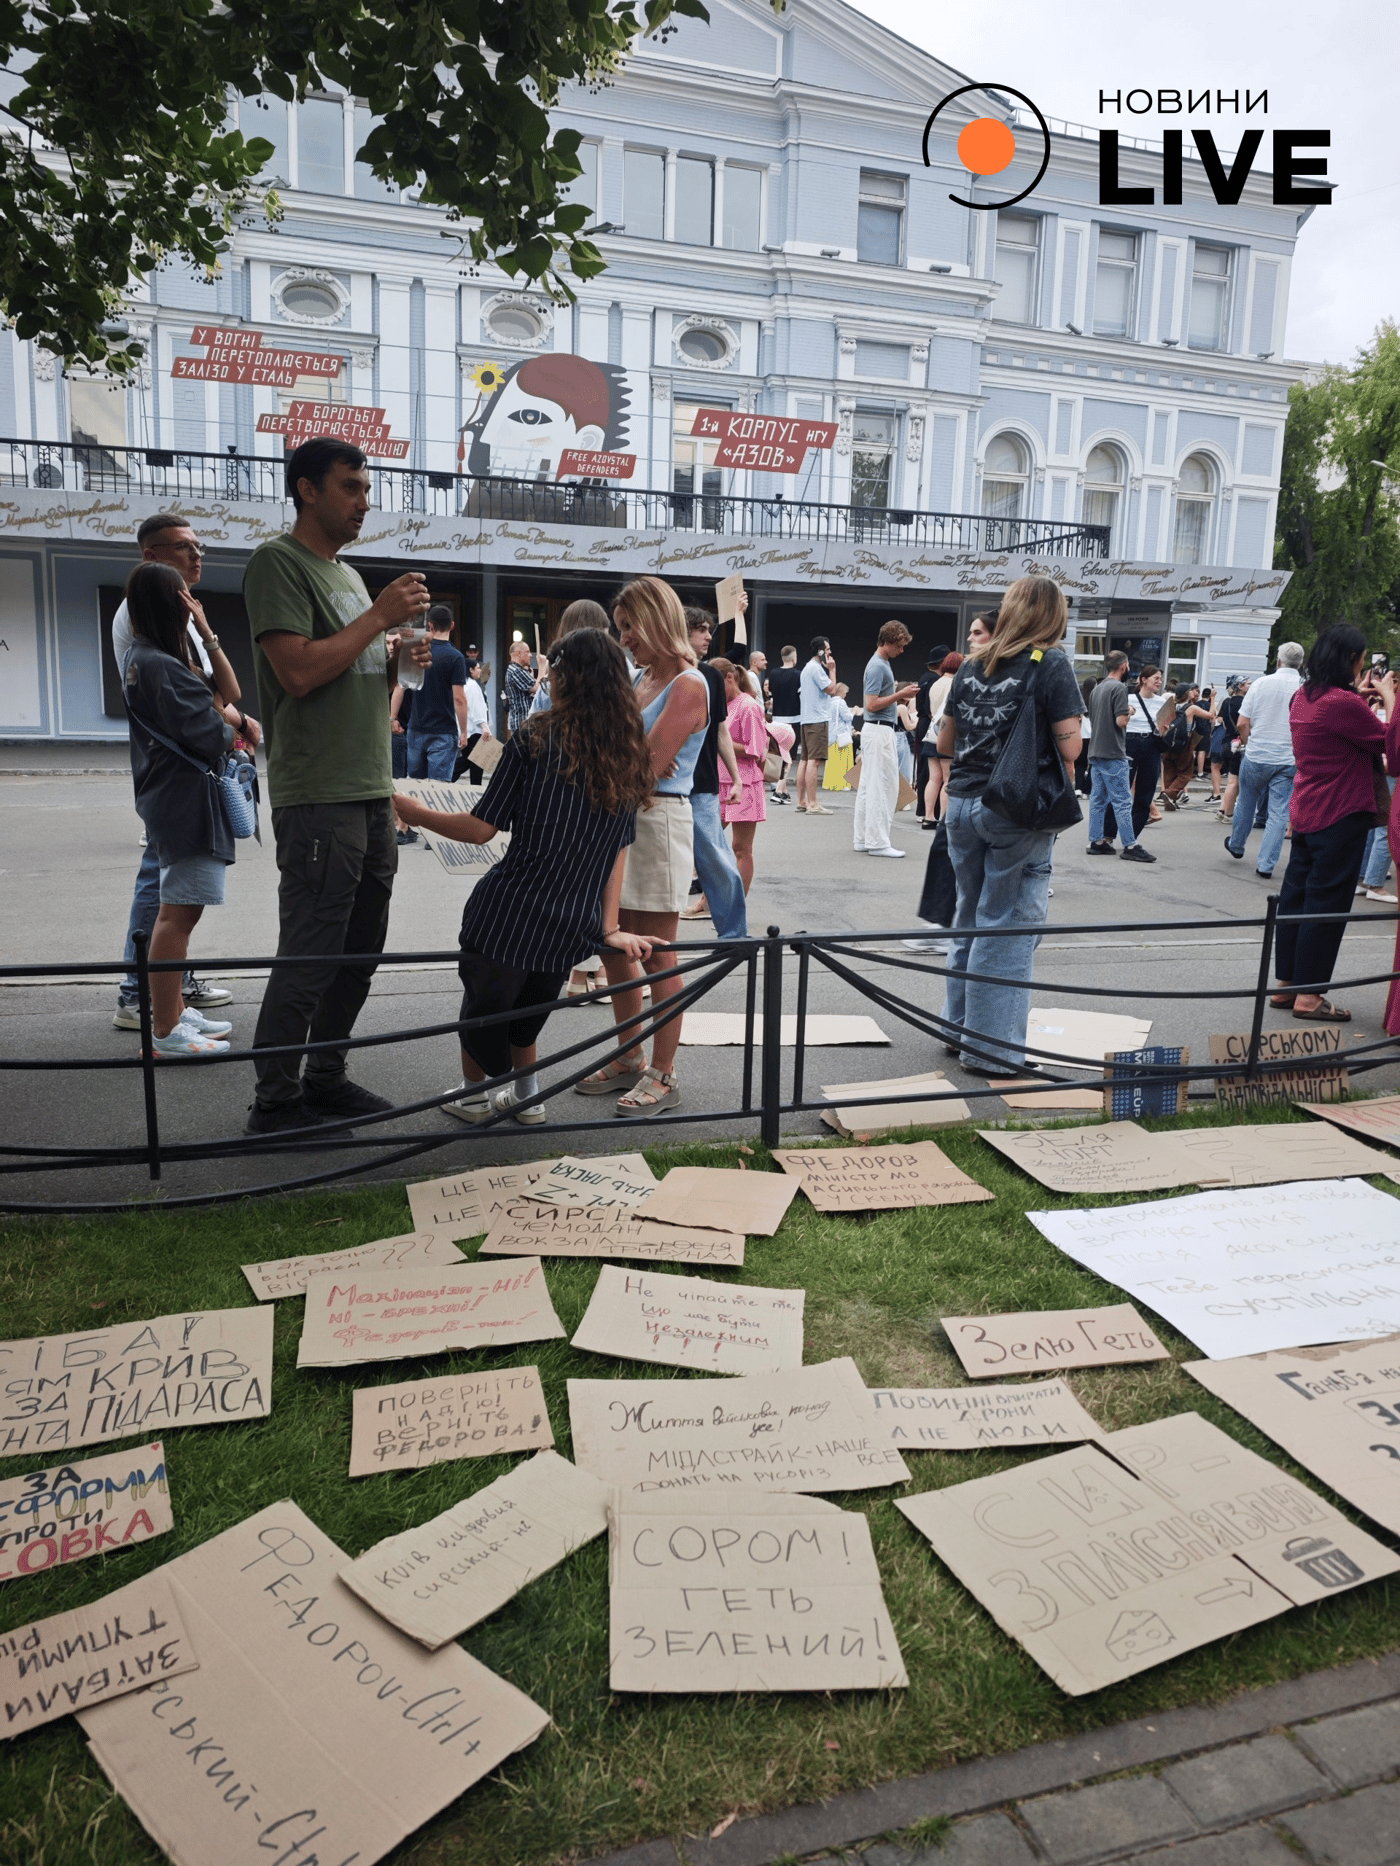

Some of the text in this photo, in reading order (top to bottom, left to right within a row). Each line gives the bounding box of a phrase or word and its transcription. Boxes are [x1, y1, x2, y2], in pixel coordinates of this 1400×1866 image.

[198, 330, 256, 347] У ВОГНІ
[211, 348, 339, 372] ПЕРЕТОПЛЮЄТЬСЯ
[178, 362, 293, 385] ЗАЛІЗО У СТАЛЬ
[296, 404, 376, 423] У БОРОТЬБІ
[262, 416, 383, 439] ПЕРЕТВОРЮЄТЬСЯ
[700, 417, 828, 443] 1-й КОРПУС НГУ
[567, 452, 630, 467] FREE AZOVSTAL
[722, 444, 795, 467] «АЗОВ»
[577, 464, 620, 476] DEFENDERS
[786, 1154, 918, 1171] ФЕДОРОВ
[1039, 1145, 1113, 1160] ЧОРТ
[549, 1162, 611, 1185] ЛАСКА
[807, 1173, 879, 1183] МІНІСТР
[441, 1179, 479, 1199] ЦЕ
[488, 1174, 518, 1190] НЕ
[534, 1183, 570, 1198] Z
[612, 1180, 655, 1198] УДЬ
[434, 1206, 480, 1224] ЦЕ
[498, 1236, 615, 1247] ВОКЗАЛ
[624, 1275, 653, 1297] Не
[684, 1312, 761, 1329] має бути
[89, 1349, 252, 1393] КРИВ
[996, 1386, 1062, 1405] ВМИРАТИ
[2, 1391, 69, 1421] ЗА
[80, 1377, 266, 1436] ПІДАРАСА
[954, 1405, 1036, 1423] ДРОНИ
[609, 1400, 705, 1433] Життя
[919, 1427, 950, 1440] НЕ
[978, 1423, 1069, 1440] ЛЮДИ
[857, 1450, 899, 1466] ВСЕ
[21, 1467, 82, 1497] ЗА
[718, 1474, 743, 1483] НА
[0, 1509, 103, 1548] ПРОТИ
[680, 1587, 813, 1614] ГЕТЬ
[18, 1606, 168, 1678] ТУПИМИ
[625, 1617, 888, 1661] ЗЕЛЕНИЙ!
